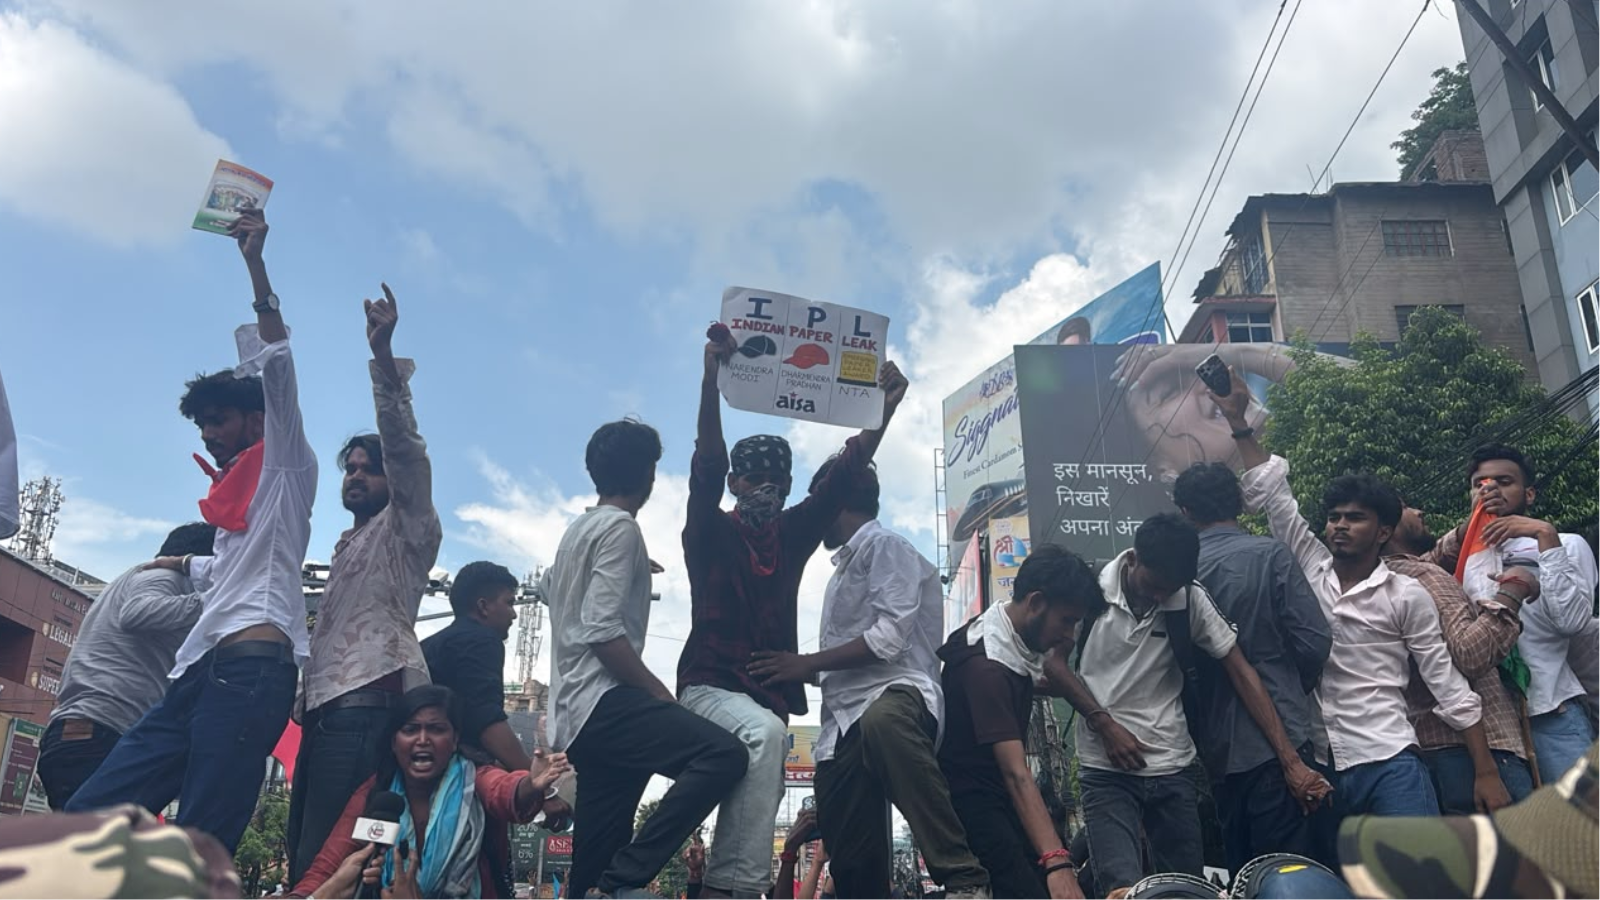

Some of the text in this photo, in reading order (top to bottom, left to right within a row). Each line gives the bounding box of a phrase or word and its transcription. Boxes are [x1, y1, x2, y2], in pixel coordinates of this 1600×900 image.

[747, 298, 871, 337] I P L
[731, 318, 877, 352] INDIAN PAPER LEAK
[726, 363, 774, 375] NARENDRA
[731, 372, 760, 383] MODI
[781, 370, 831, 383] DHARMENDRA
[786, 379, 822, 391] PRADHAN
[839, 387, 870, 398] NTA
[776, 392, 815, 413] aisa
[1053, 463, 1153, 485] इस मानसून,
[1056, 485, 1110, 507] निखारें
[1060, 519, 1110, 536] अपना
